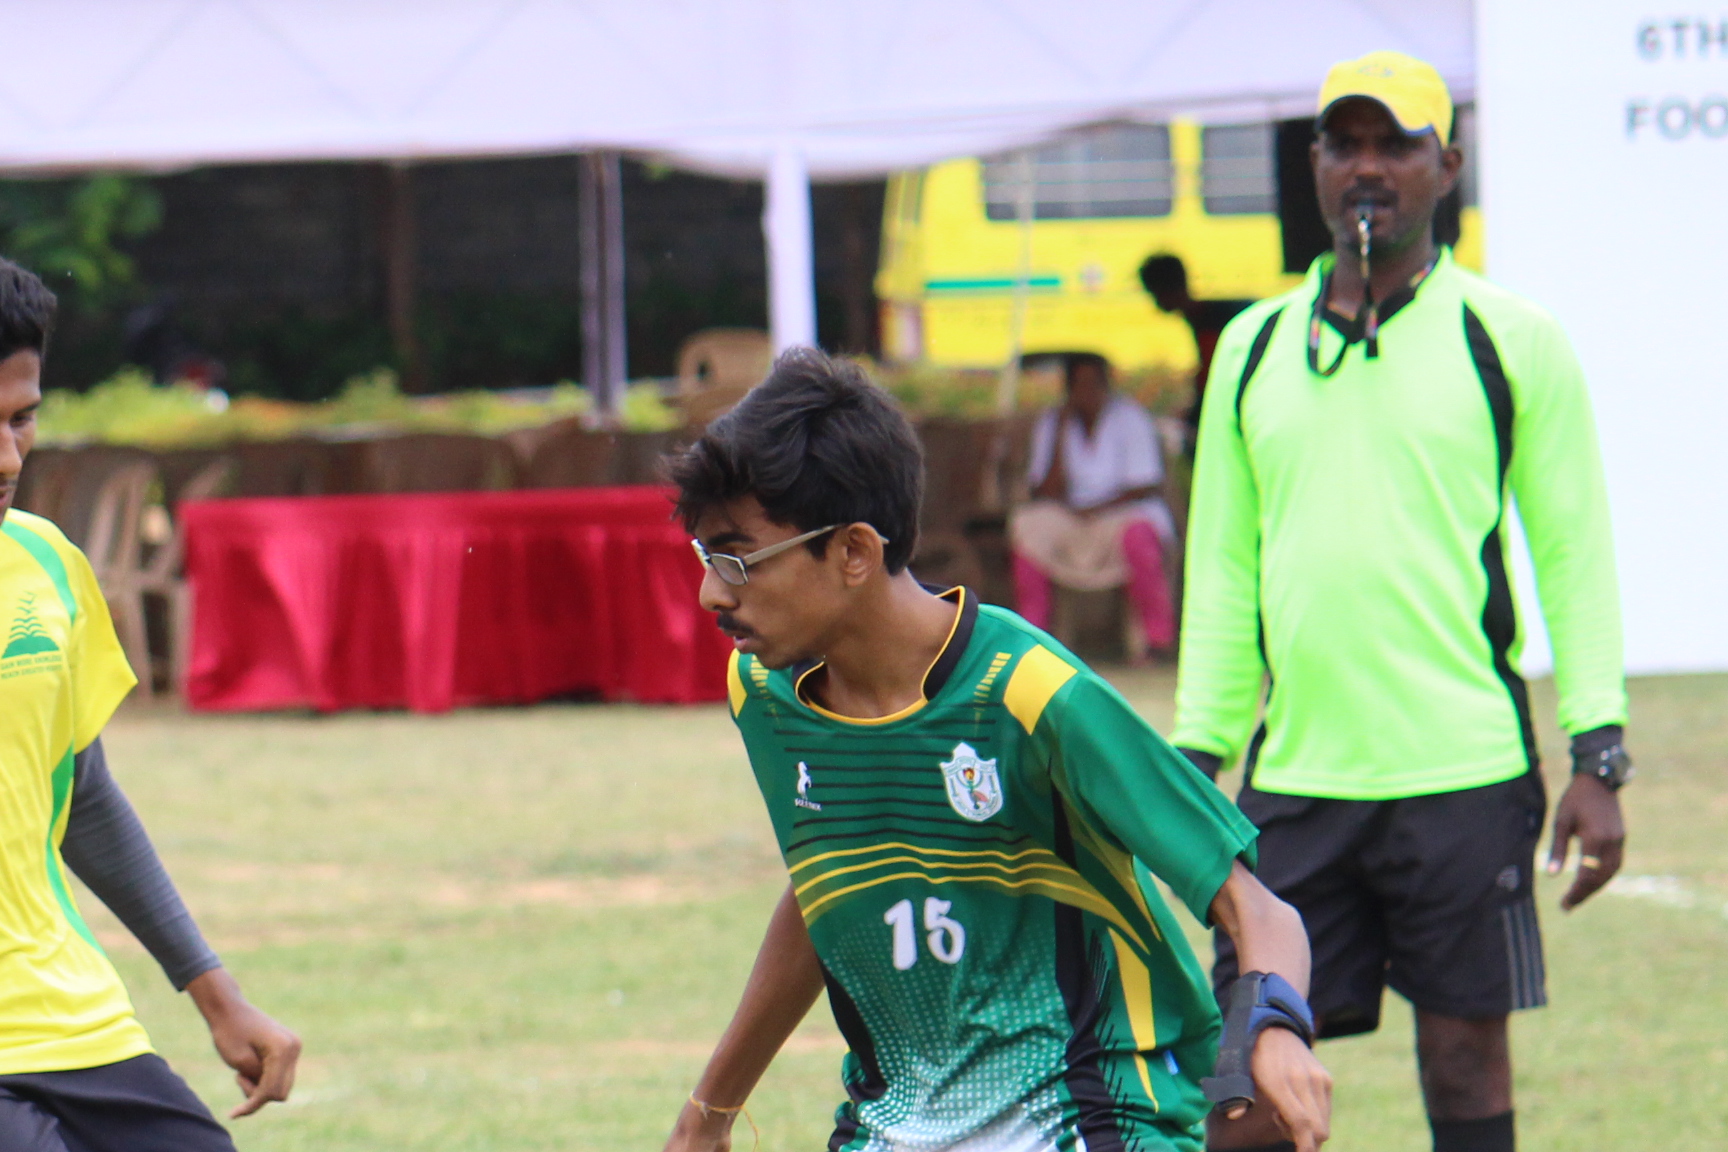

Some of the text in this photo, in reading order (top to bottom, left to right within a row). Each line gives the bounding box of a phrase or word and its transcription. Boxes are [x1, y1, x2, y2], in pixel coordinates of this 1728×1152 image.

[1637, 18, 1728, 61] 6TH
[1625, 95, 1728, 141] FOO
[883, 896, 966, 971] 15
